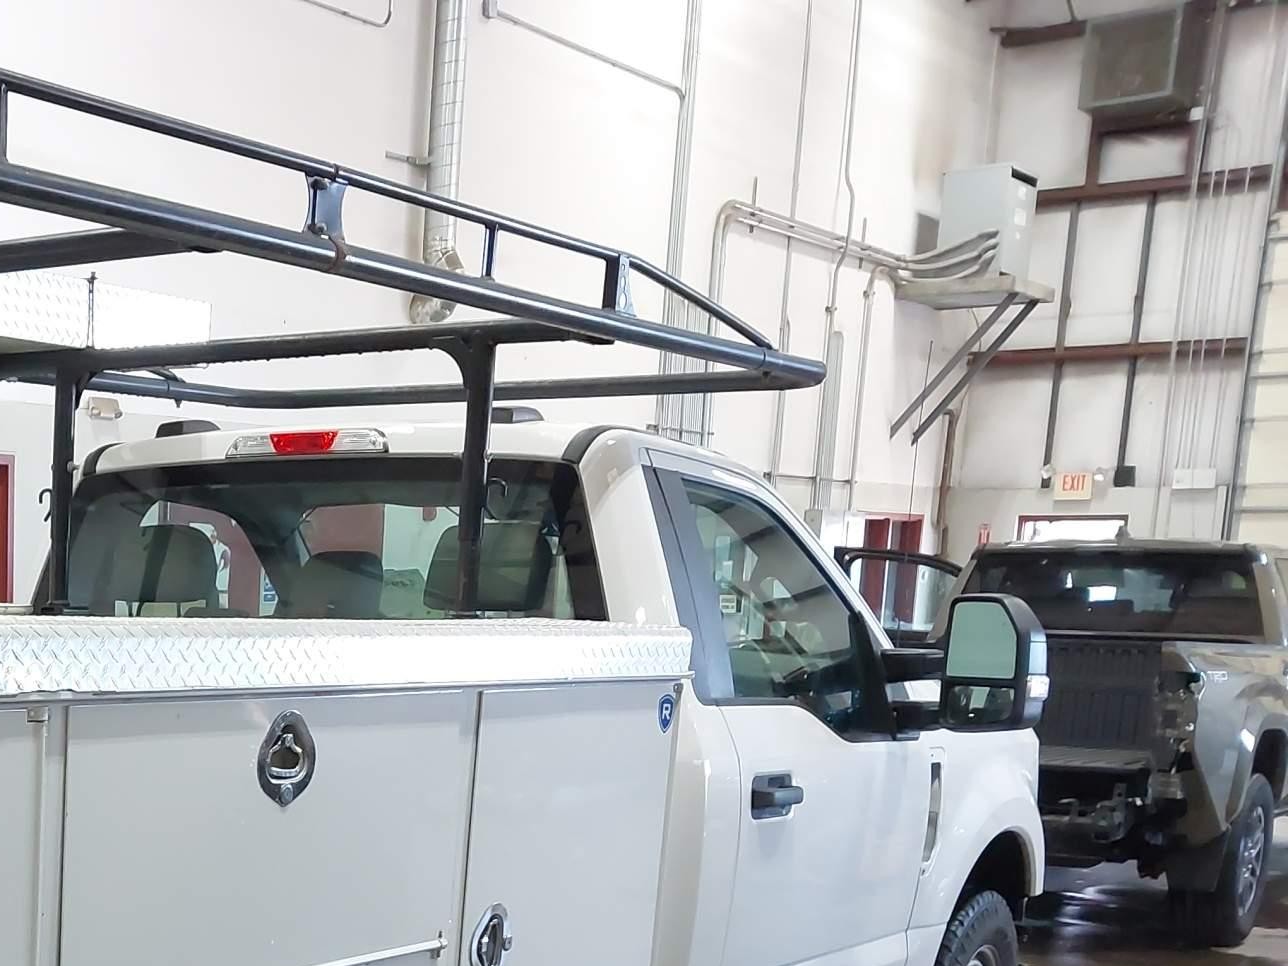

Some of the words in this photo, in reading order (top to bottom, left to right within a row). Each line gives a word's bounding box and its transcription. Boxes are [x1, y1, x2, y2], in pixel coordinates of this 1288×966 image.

[1062, 474, 1086, 491] EXIT
[1207, 670, 1228, 683] TRD
[662, 703, 672, 721] R
